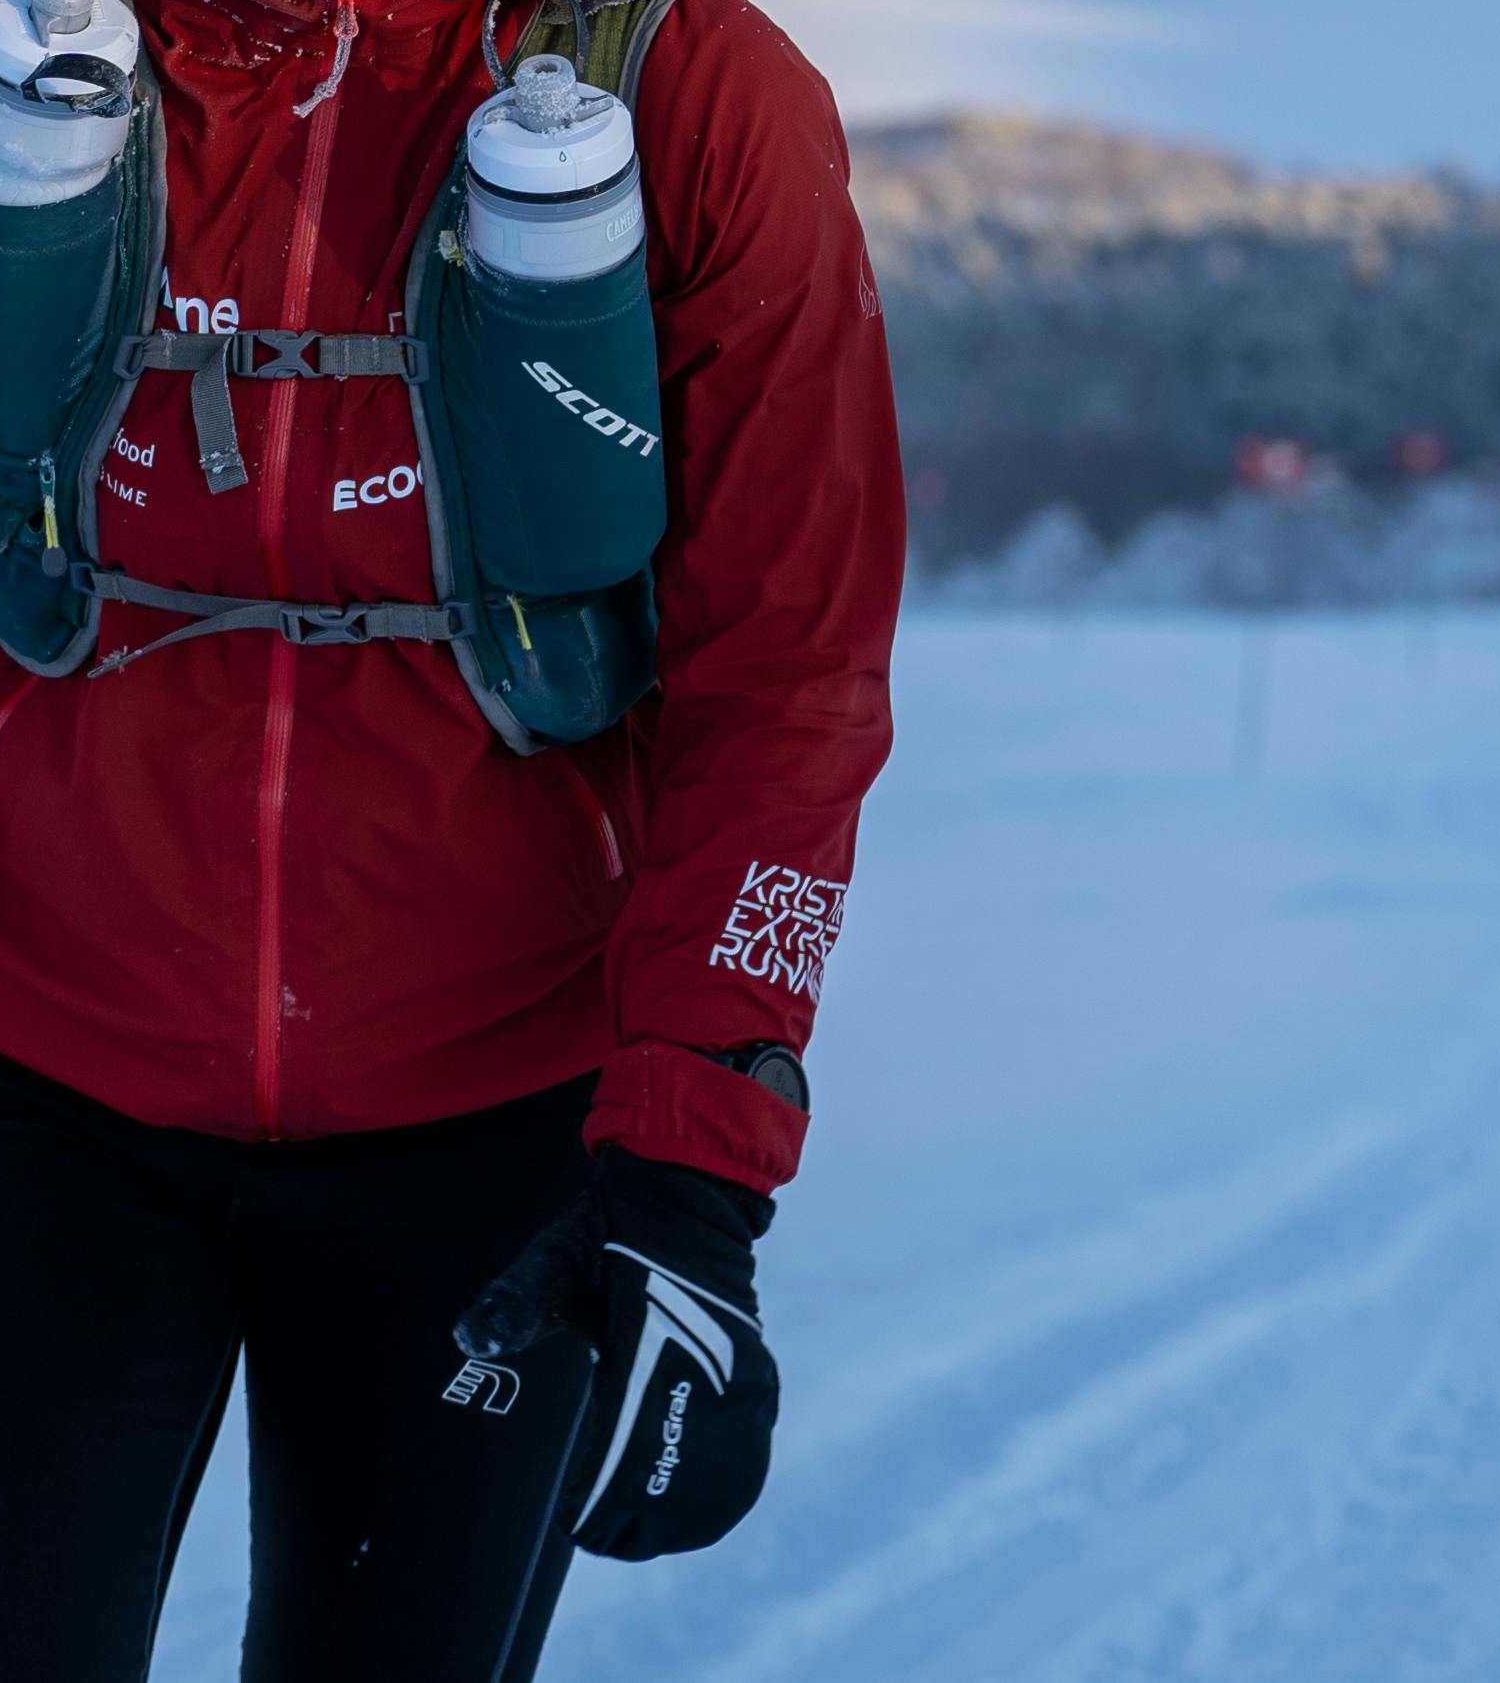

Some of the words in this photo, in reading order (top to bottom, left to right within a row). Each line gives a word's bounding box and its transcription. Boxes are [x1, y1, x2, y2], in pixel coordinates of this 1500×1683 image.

[520, 361, 660, 457] SCOTT
[332, 460, 425, 512] ECO
[708, 932, 825, 1007] RUNN
[645, 1380, 693, 1496] GripGrab
